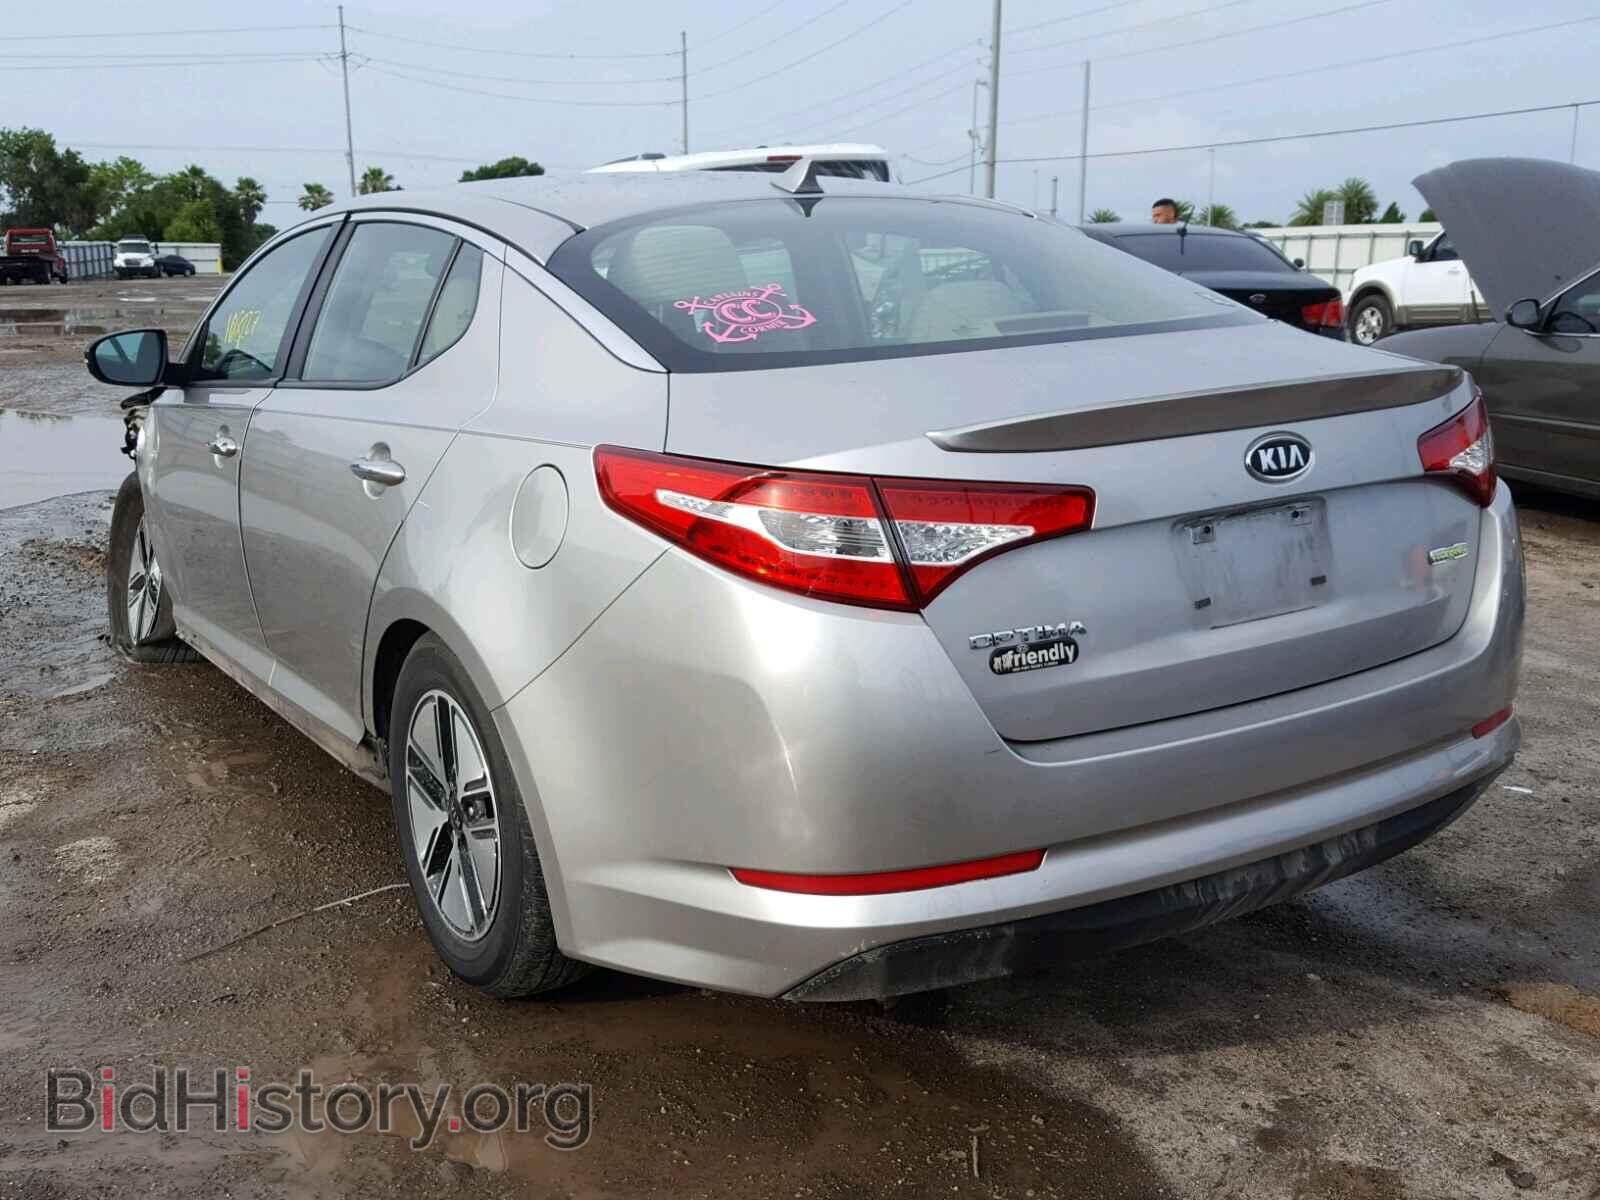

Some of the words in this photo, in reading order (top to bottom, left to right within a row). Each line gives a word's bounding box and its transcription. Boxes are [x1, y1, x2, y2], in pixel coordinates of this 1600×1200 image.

[720, 299, 777, 323] CC
[1257, 444, 1305, 473] KIA
[968, 620, 1087, 650] OPTIMA
